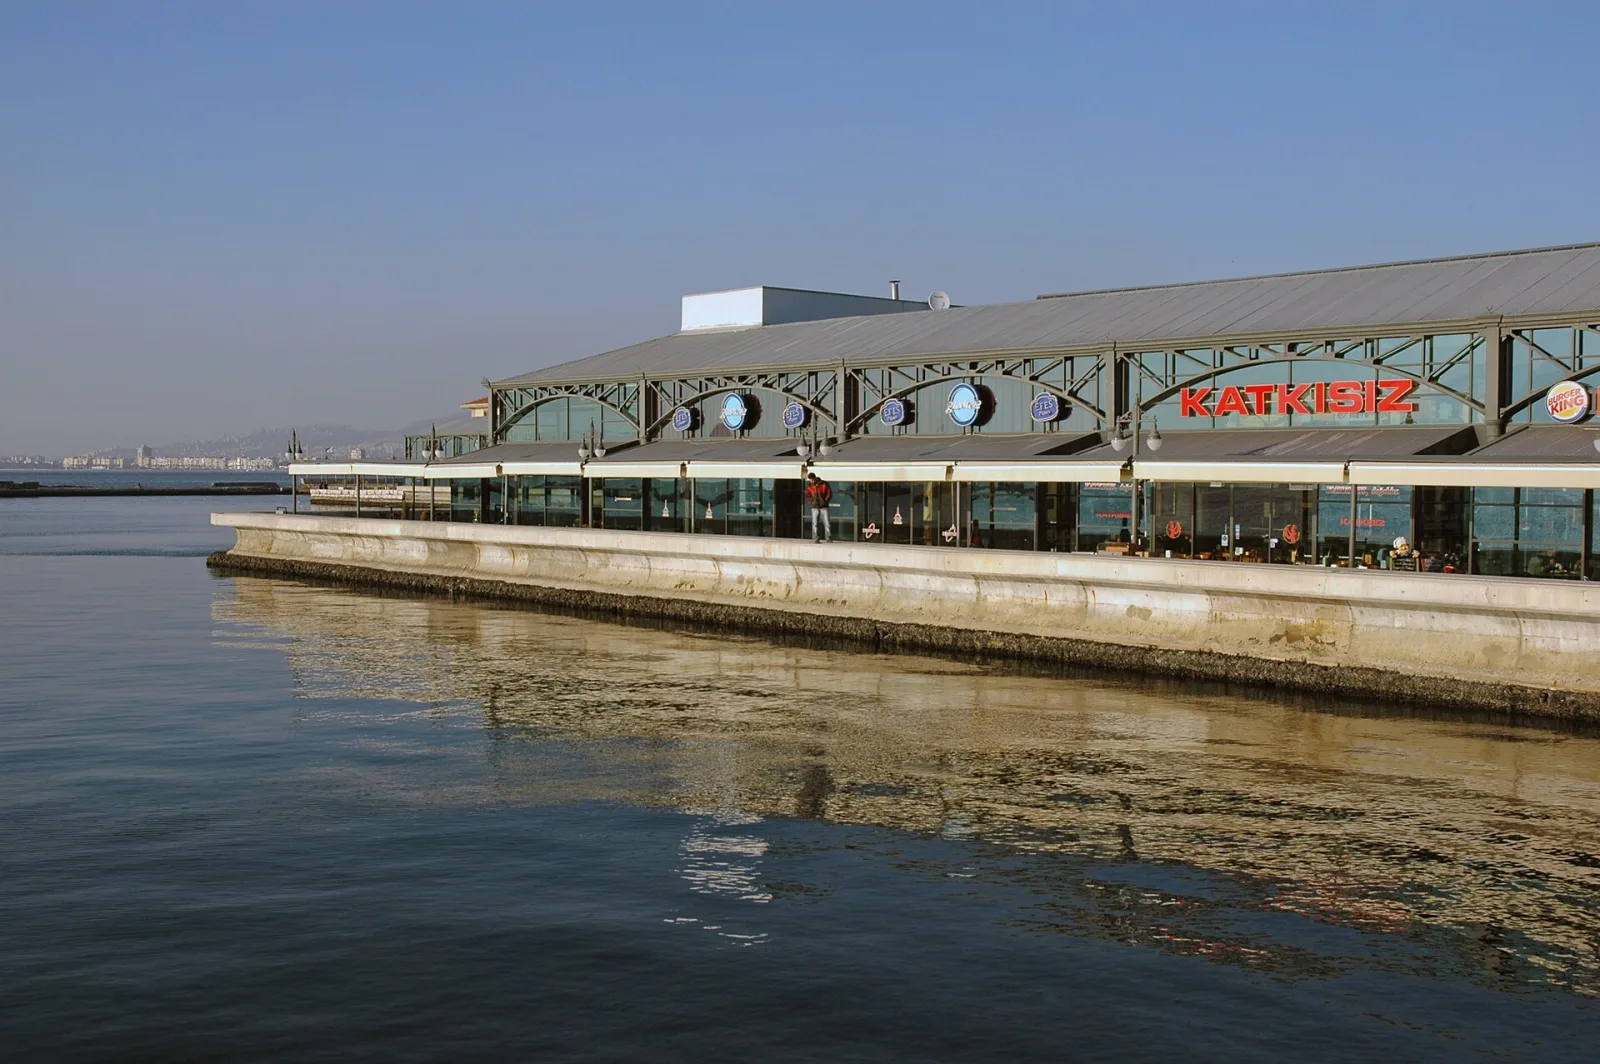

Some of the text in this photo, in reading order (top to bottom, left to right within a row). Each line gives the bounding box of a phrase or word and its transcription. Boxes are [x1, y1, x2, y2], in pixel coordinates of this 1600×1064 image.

[1035, 400, 1053, 411] EFES
[1180, 378, 1413, 417] KATKISIZ
[1548, 388, 1581, 406] BURGER
[1551, 395, 1584, 415] KING
[884, 406, 901, 416] EFES
